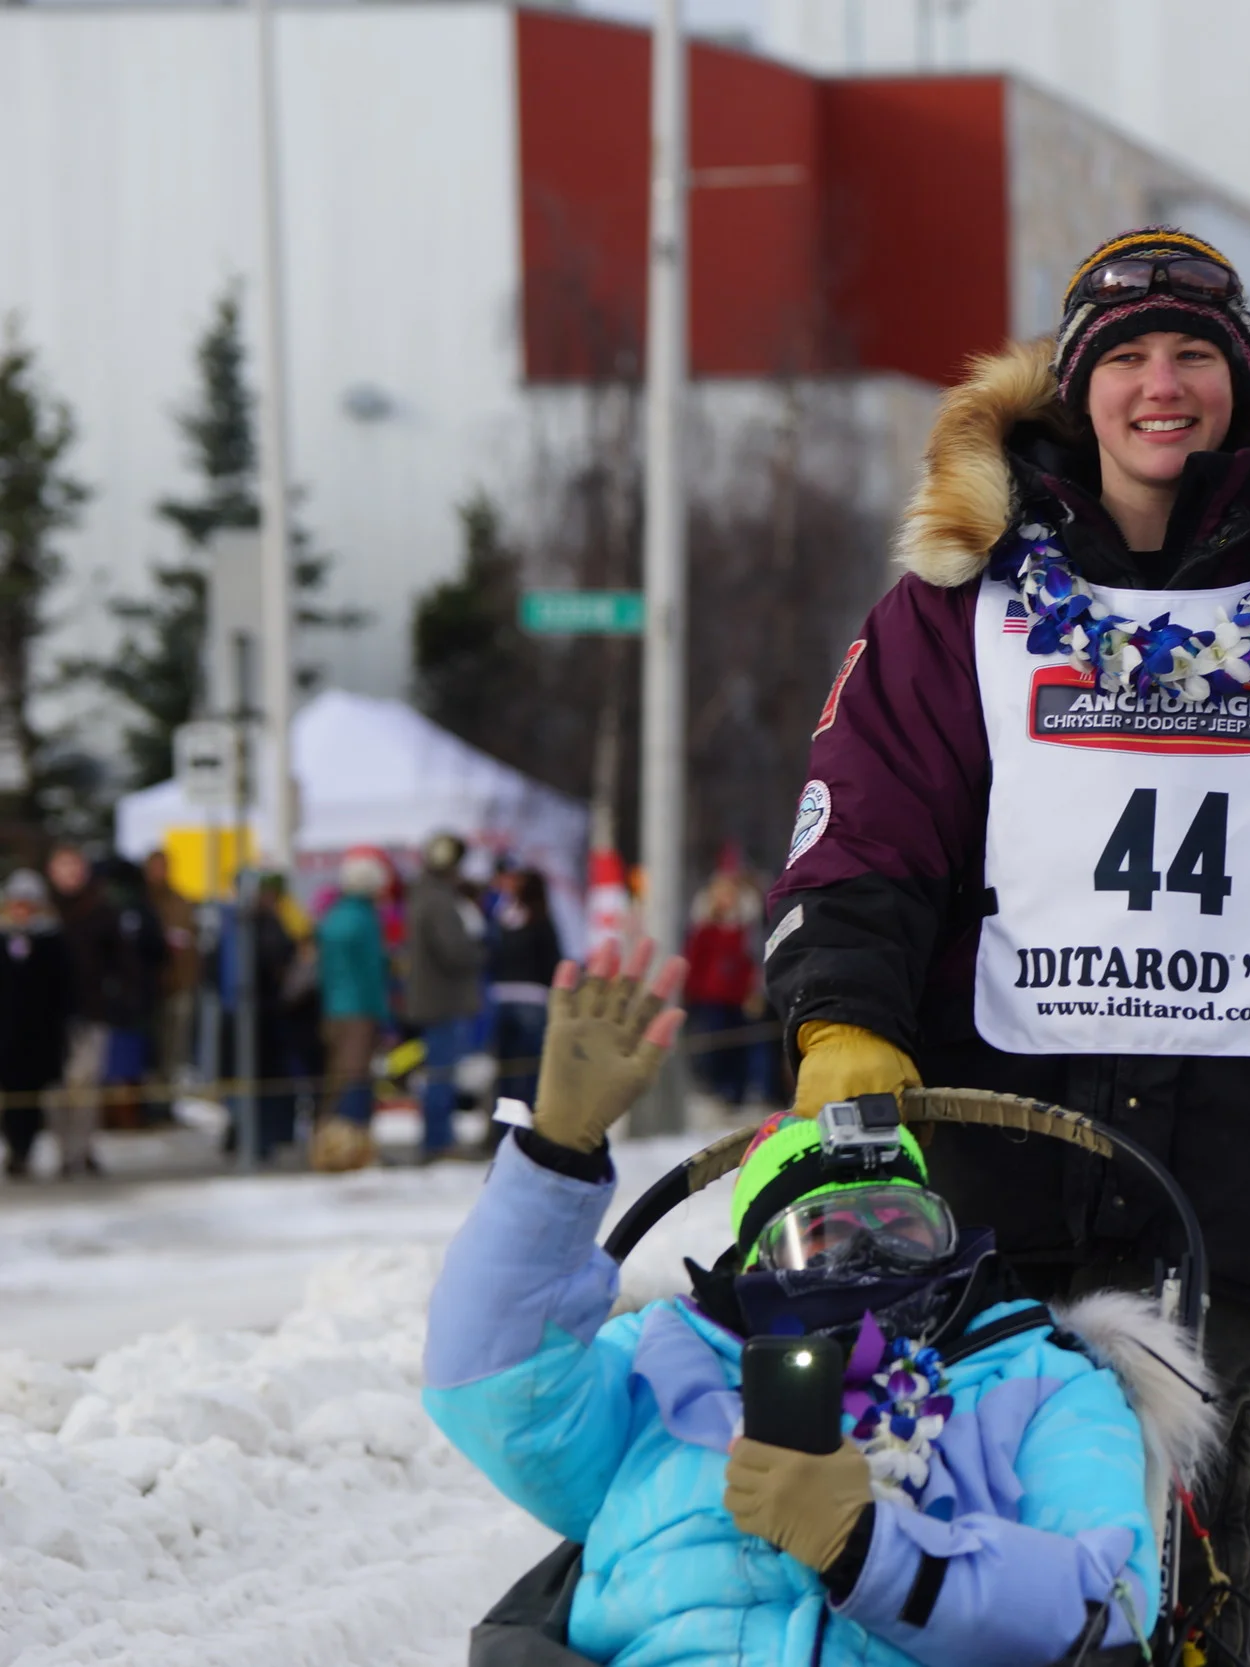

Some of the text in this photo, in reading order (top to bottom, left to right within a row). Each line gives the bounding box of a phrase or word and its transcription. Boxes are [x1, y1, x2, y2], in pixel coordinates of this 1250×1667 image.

[1043, 714, 1122, 729] CHRYSLER
[1134, 716, 1197, 730] DODGE
[1208, 719, 1247, 734] JEEP
[1094, 787, 1232, 915] 44
[1014, 946, 1230, 994] IDITAROD
